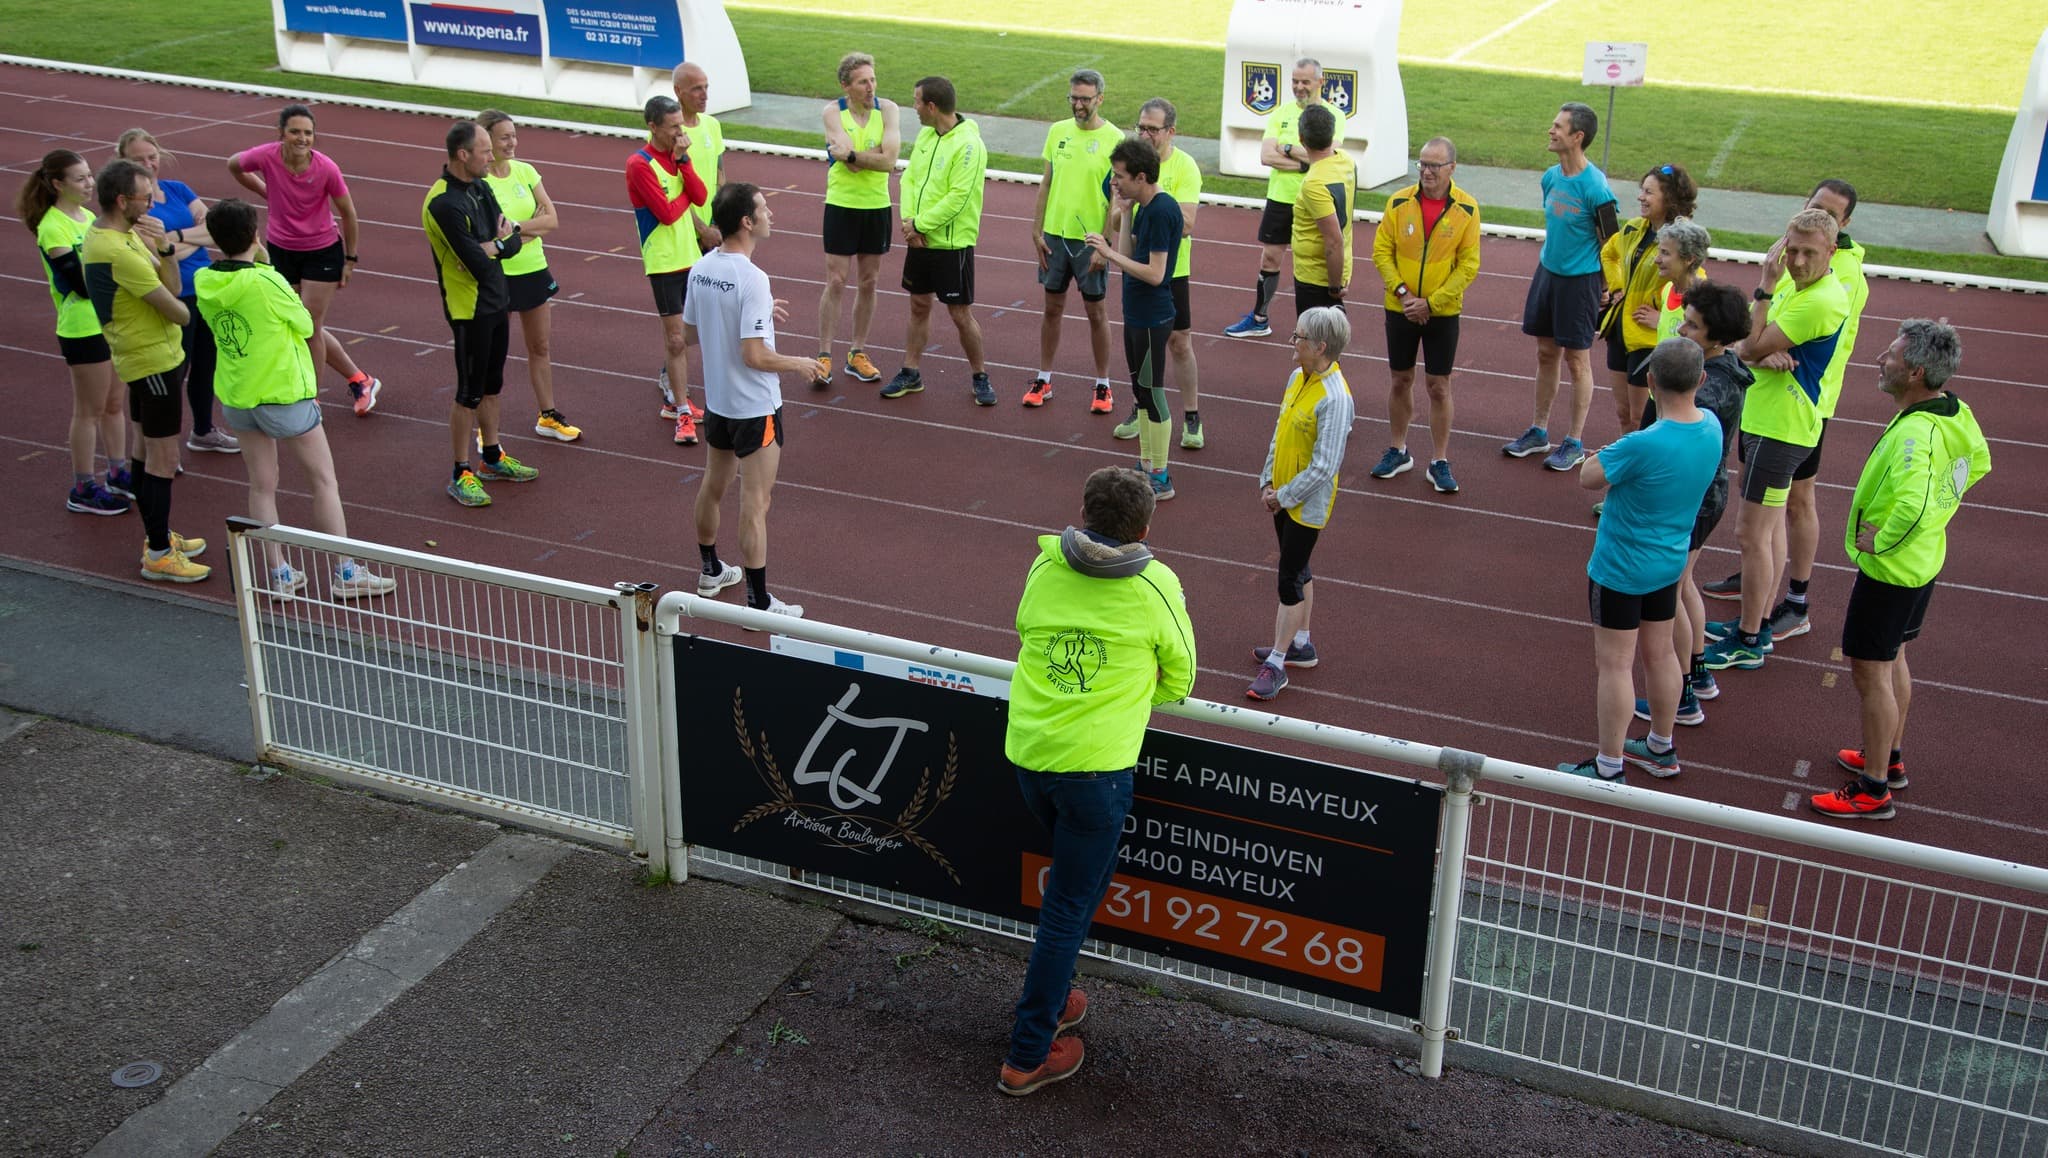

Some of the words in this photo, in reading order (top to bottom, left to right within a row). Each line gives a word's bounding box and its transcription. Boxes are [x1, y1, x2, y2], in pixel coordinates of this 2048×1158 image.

[423, 20, 529, 42] www.ixperia.fr
[570, 17, 579, 25] EN
[580, 18, 599, 27] PLEIN
[585, 31, 597, 42] 02
[598, 33, 608, 43] 31
[609, 34, 621, 44] 22
[1247, 65, 1276, 75] BAYEUX
[1046, 673, 1074, 695] BAYEUX
[1134, 756, 1169, 780] HE
[1174, 763, 1193, 785] A
[1200, 767, 1261, 799] PAIN
[1269, 783, 1379, 825] BAYEUX
[783, 810, 832, 836] Artisan
[837, 822, 903, 851] Boulanger
[1146, 818, 1323, 877] D'EINDHOVEN
[1118, 844, 1183, 875] 4400
[1191, 859, 1296, 902] BAYEUX
[1105, 881, 1151, 923] 31
[1166, 896, 1221, 940] 92
[1236, 911, 1289, 957] 72
[1303, 931, 1364, 974] 68
